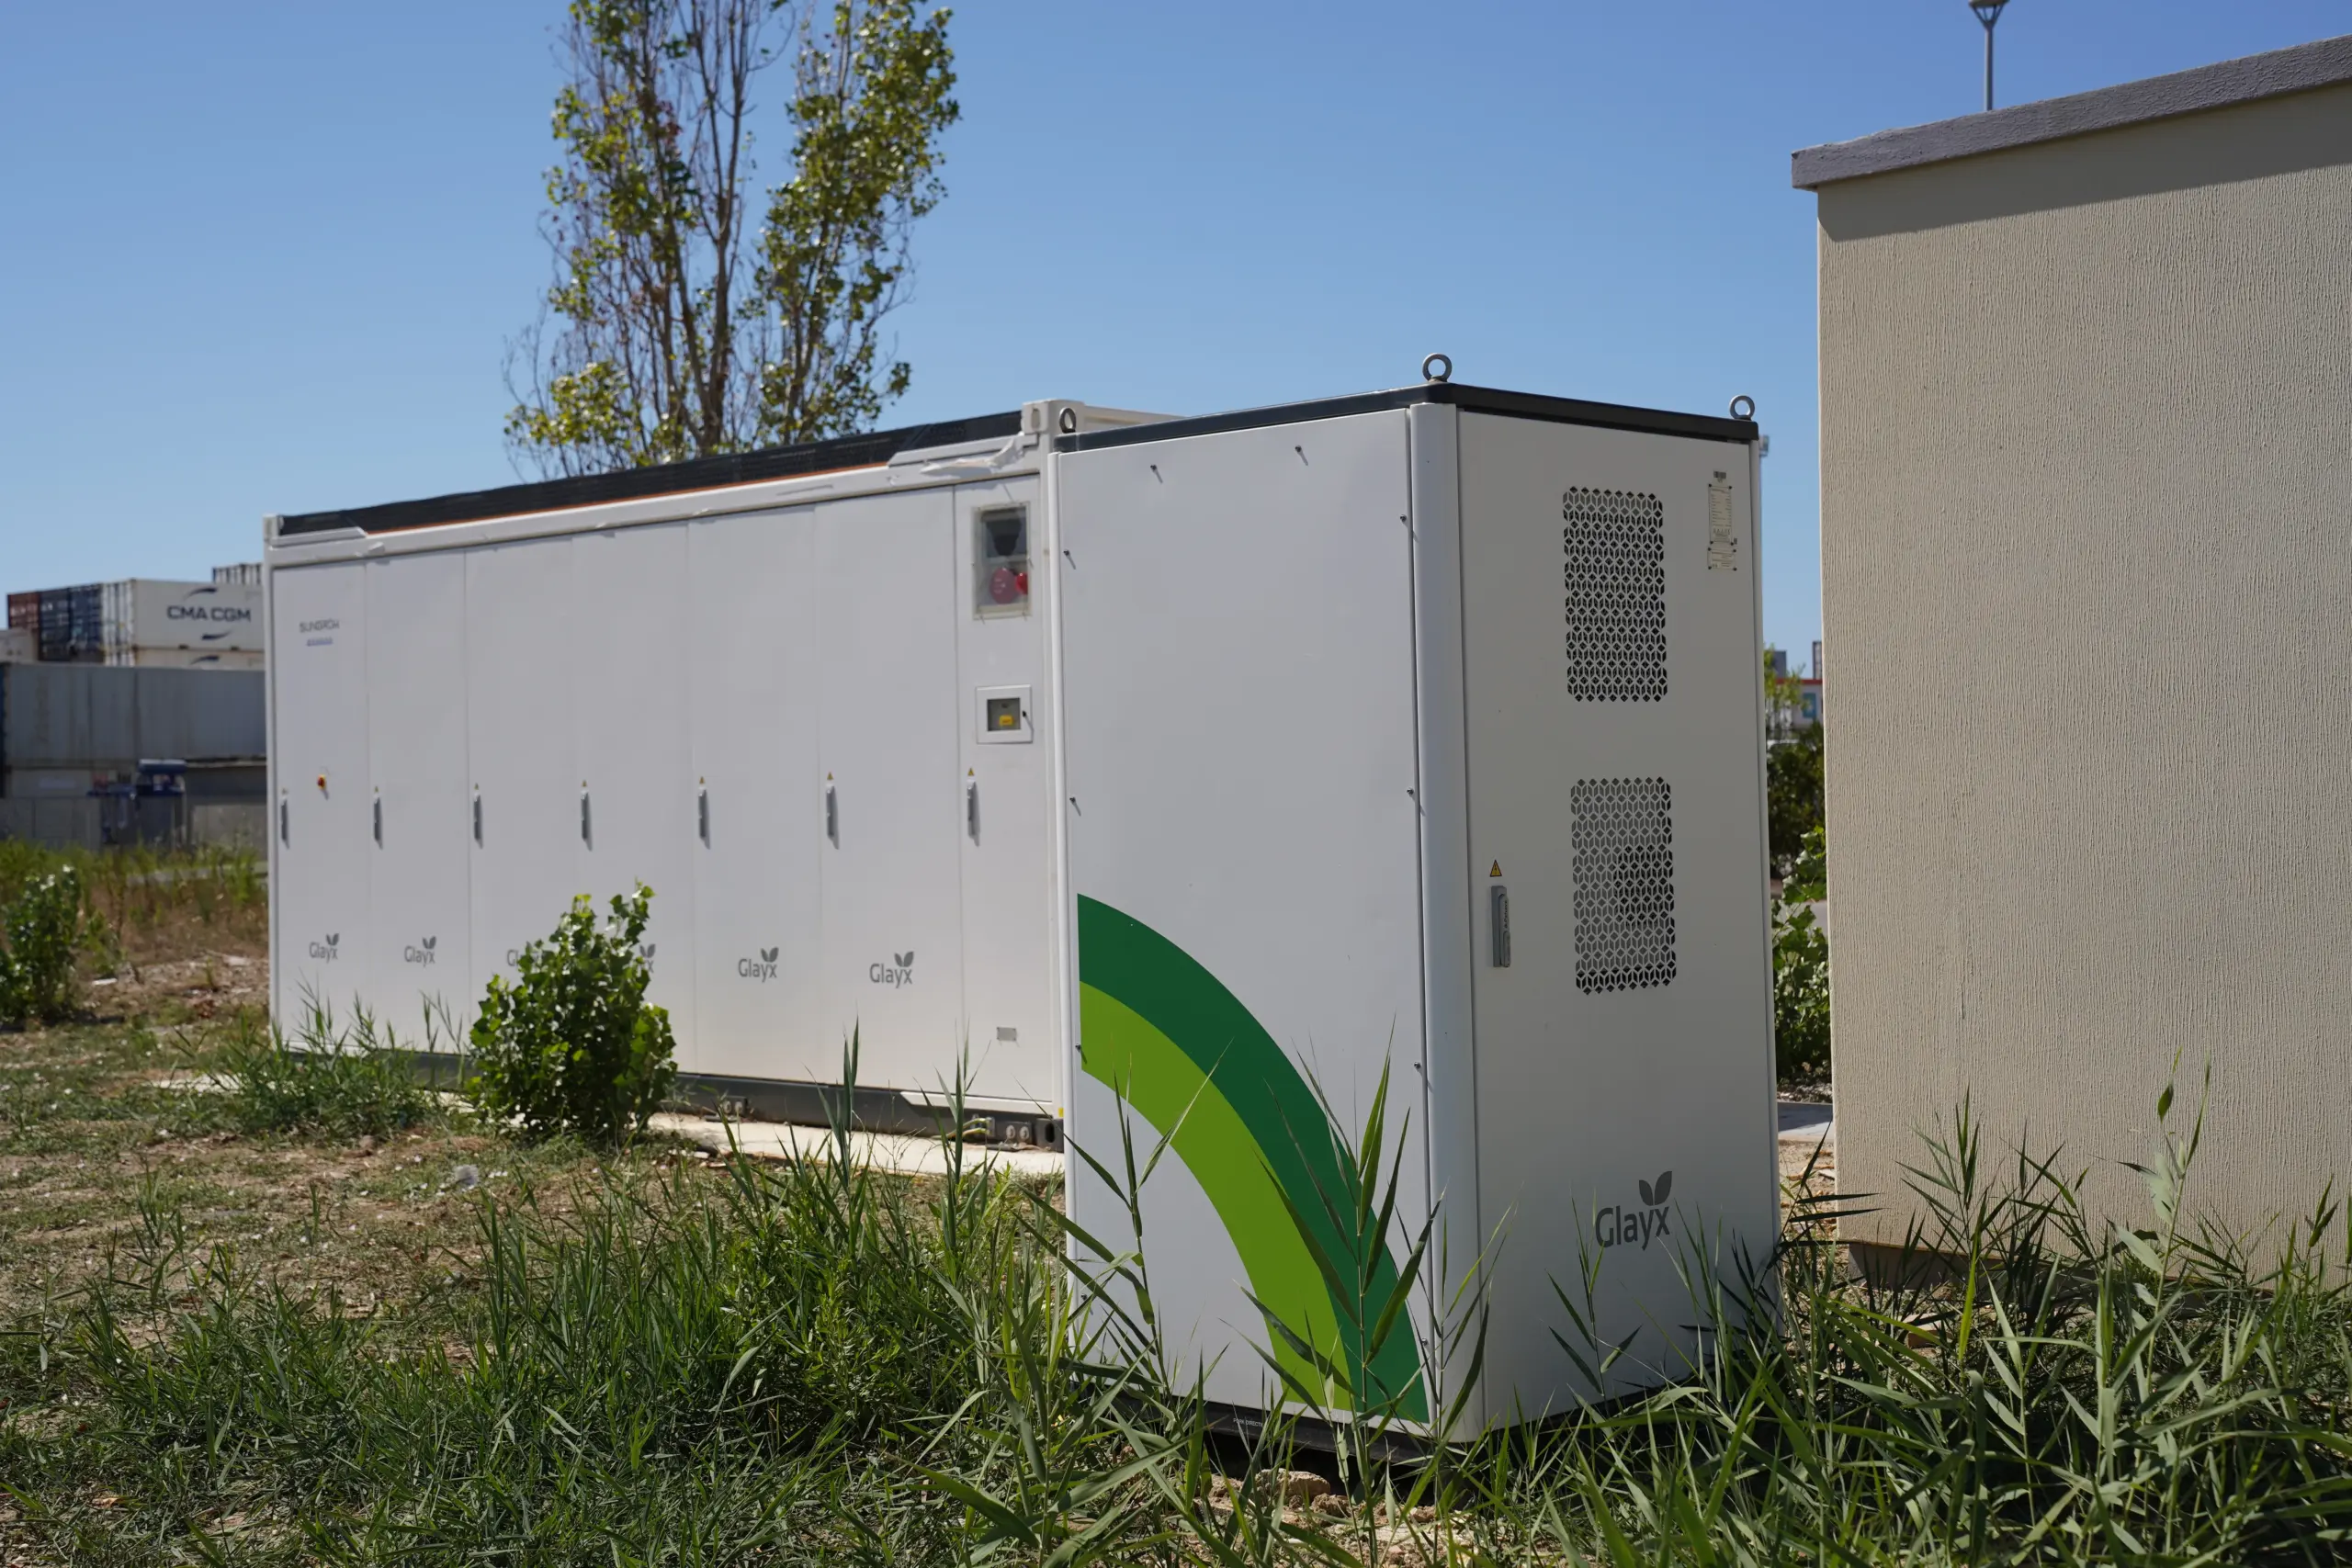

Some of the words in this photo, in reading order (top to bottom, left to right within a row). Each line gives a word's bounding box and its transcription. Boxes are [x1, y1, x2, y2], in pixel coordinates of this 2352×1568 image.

[167, 605, 208, 620] CMA
[210, 606, 251, 623] CGM
[738, 958, 777, 983] Glayx
[869, 963, 913, 988] Glayx
[1596, 1205, 1670, 1251] Glayx
